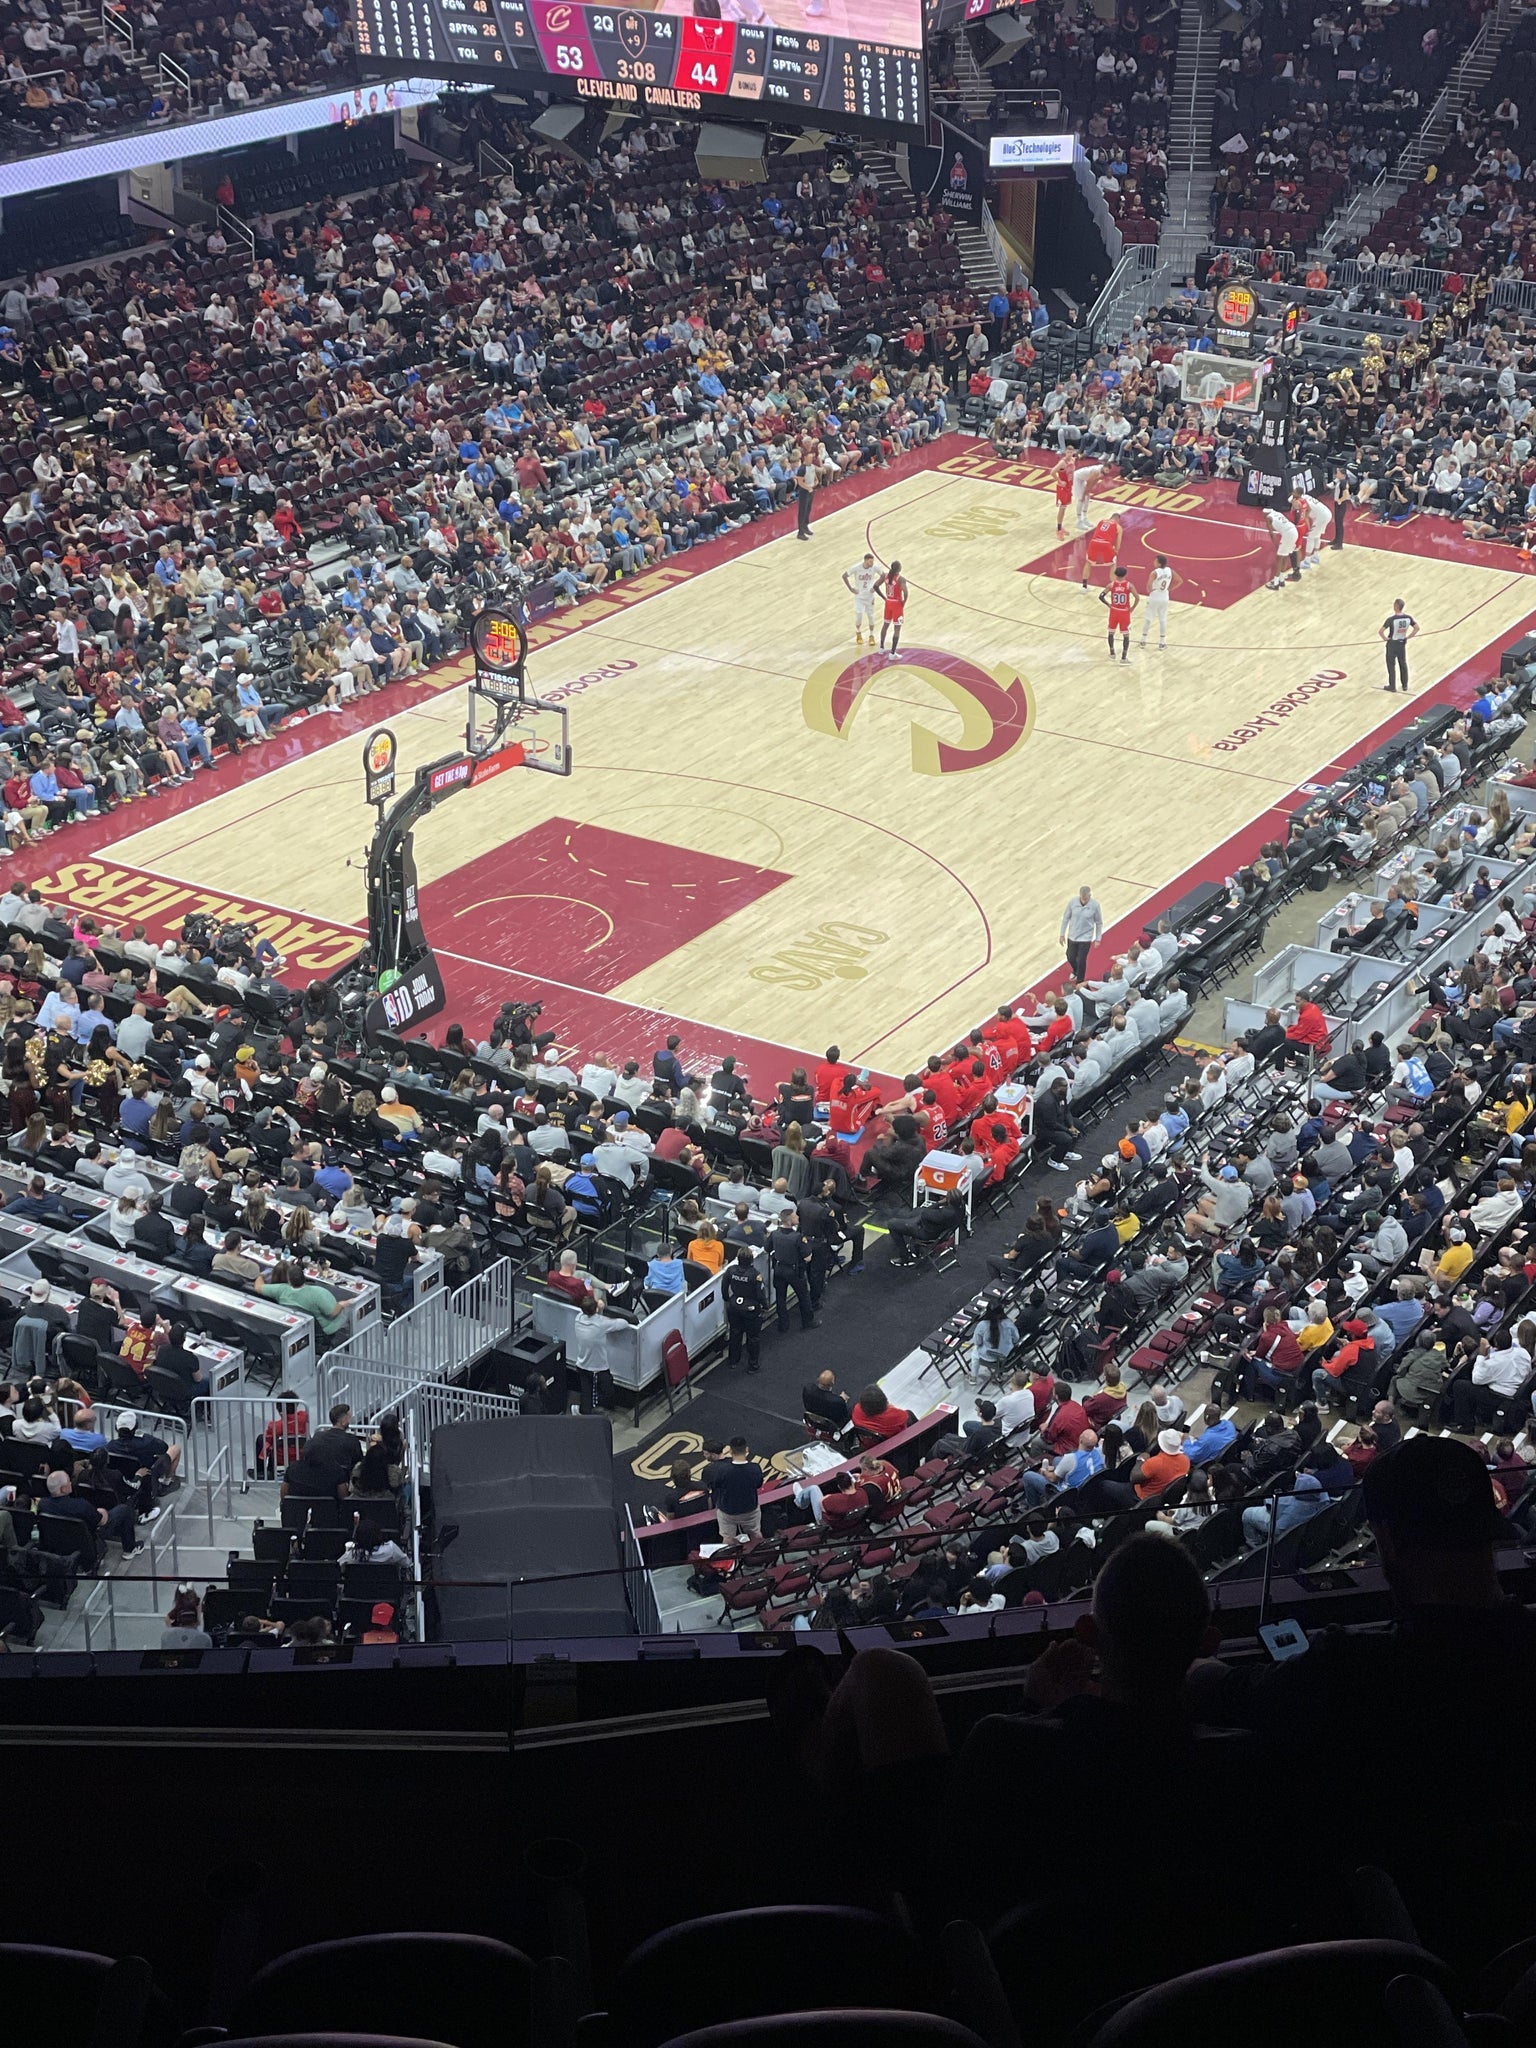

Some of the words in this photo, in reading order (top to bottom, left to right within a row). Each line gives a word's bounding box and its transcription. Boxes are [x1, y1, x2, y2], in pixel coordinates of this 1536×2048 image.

[391, 1, 398, 11] 0
[375, 11, 382, 21] 6
[424, 15, 431, 25] 0
[593, 15, 614, 33] 2Q
[376, 22, 383, 32] 7
[410, 25, 418, 35] 2
[449, 22, 478, 36] 3PT%
[482, 24, 497, 36] 26
[514, 21, 524, 37] 5
[654, 21, 673, 38] 24
[378, 34, 385, 44] 0
[395, 35, 402, 45] 0
[411, 36, 418, 47] 2
[775, 35, 800, 50] FG%
[806, 38, 821, 53] 48
[379, 45, 387, 56] 6
[413, 48, 420, 59] 0
[428, 49, 435, 60] 3
[457, 47, 479, 60] TOL
[494, 50, 502, 62] 6
[556, 44, 583, 70] 53
[746, 48, 756, 65] 3
[858, 43, 872, 52] PTS
[892, 48, 906, 57] AST
[773, 58, 802, 73] 3PT%
[804, 62, 819, 77] 29
[844, 52, 851, 63] 9
[861, 55, 868, 66] 0
[878, 57, 885, 69] 3
[616, 59, 656, 82] 3:08
[691, 62, 718, 88] 44
[843, 64, 853, 76] 11
[860, 67, 872, 79] 12
[879, 70, 886, 81] 2
[911, 75, 918, 86] 0
[577, 77, 638, 102] CLEVELAND
[644, 86, 702, 111] CAVALIERS
[768, 84, 790, 98] TOL
[803, 88, 811, 102] 5
[843, 77, 855, 88] 13
[862, 80, 869, 91] 0
[911, 88, 918, 99] 3
[843, 89, 856, 100] 30
[863, 92, 870, 103] 2
[897, 97, 904, 109] 0
[844, 101, 857, 112] 35
[863, 104, 871, 116] 6
[897, 109, 905, 121] 0
[1022, 141, 1062, 155] Technologies
[942, 189, 973, 201] SHERWIN
[1229, 291, 1251, 304] 3:08
[1223, 301, 1249, 324] 24
[937, 456, 1206, 512] CLEVAND
[1260, 471, 1282, 487] League
[1259, 483, 1275, 496] Pass
[1113, 593, 1126, 605] 30
[490, 620, 516, 639] 3:08
[485, 633, 516, 664] 24
[488, 673, 520, 685] TISSOT
[541, 667, 628, 703] Rocke
[1262, 678, 1337, 718] Rocket
[1212, 715, 1280, 752] Arena
[434, 773, 445, 788] GET
[749, 921, 891, 991] CAVS
[412, 973, 428, 995] JOIN
[414, 985, 435, 1010] TODAY
[933, 1121, 948, 1141] 25
[932, 1171, 945, 1183] G
[731, 1274, 749, 1282] POLICE
[120, 1336, 146, 1361] 34
